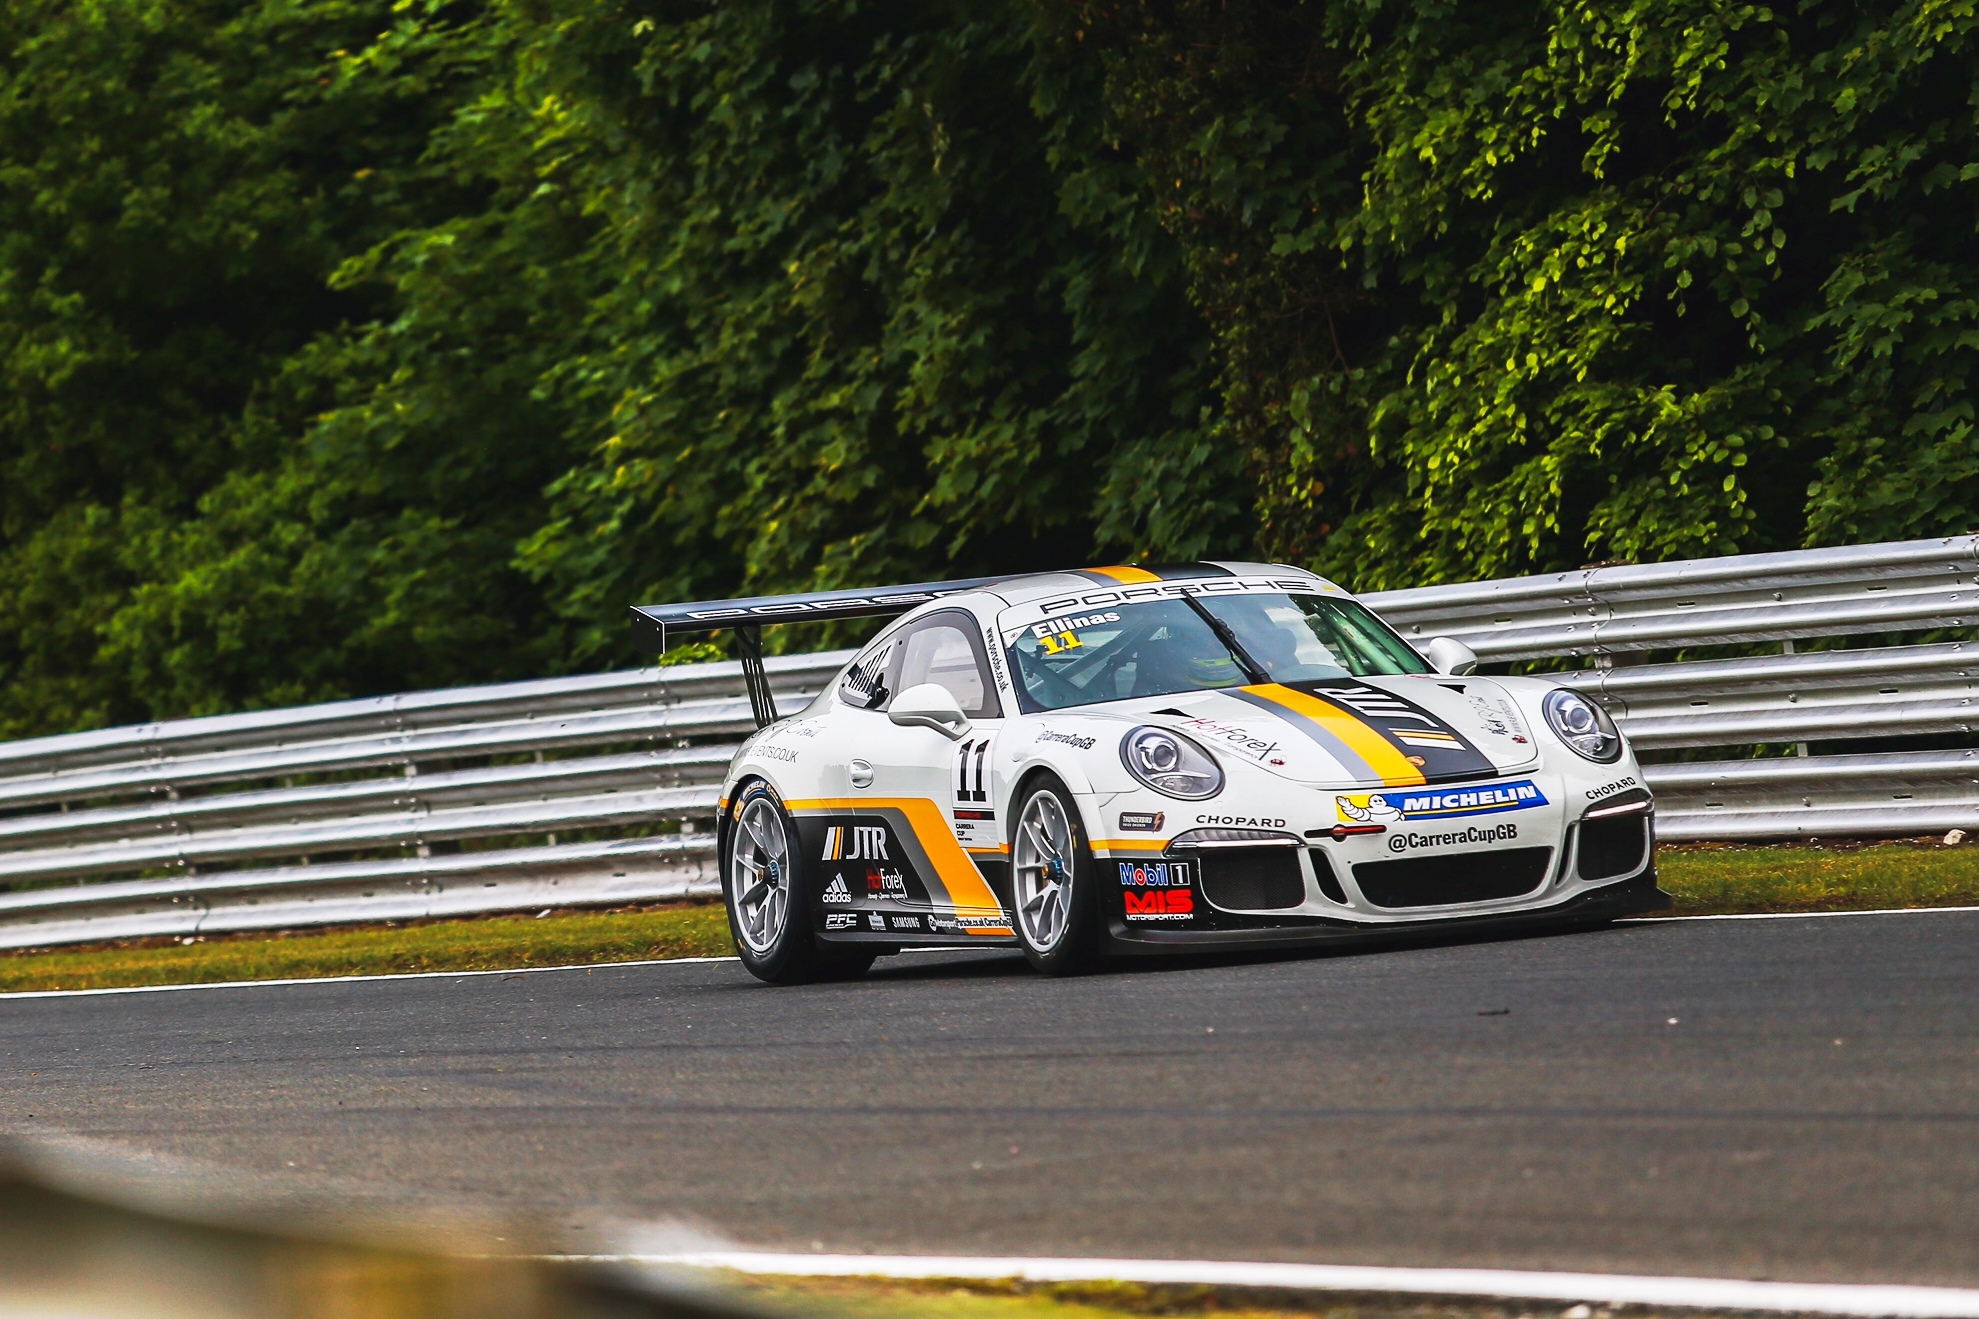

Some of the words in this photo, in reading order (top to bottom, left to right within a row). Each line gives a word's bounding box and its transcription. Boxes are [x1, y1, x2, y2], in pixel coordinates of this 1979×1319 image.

[1040, 580, 1315, 615] PORSCHE
[1030, 610, 1122, 640] Ellinas
[1038, 630, 1084, 656] 11
[986, 627, 1009, 693] www.porsche.co.uk
[956, 739, 991, 802] 11
[1403, 785, 1538, 812] MICHELIN
[1585, 776, 1637, 800] CHOPARD
[1195, 814, 1286, 828] CHOPARD
[845, 826, 889, 860] JTR
[1388, 823, 1518, 852] @CarreraCupGB
[1119, 862, 1169, 886] Mobil
[822, 891, 852, 903] adidas
[1124, 889, 1194, 914] MIS
[826, 913, 857, 924] PFC
[891, 916, 920, 929] SAMSUNG
[1126, 913, 1194, 921] MOTORSPORT.COM
